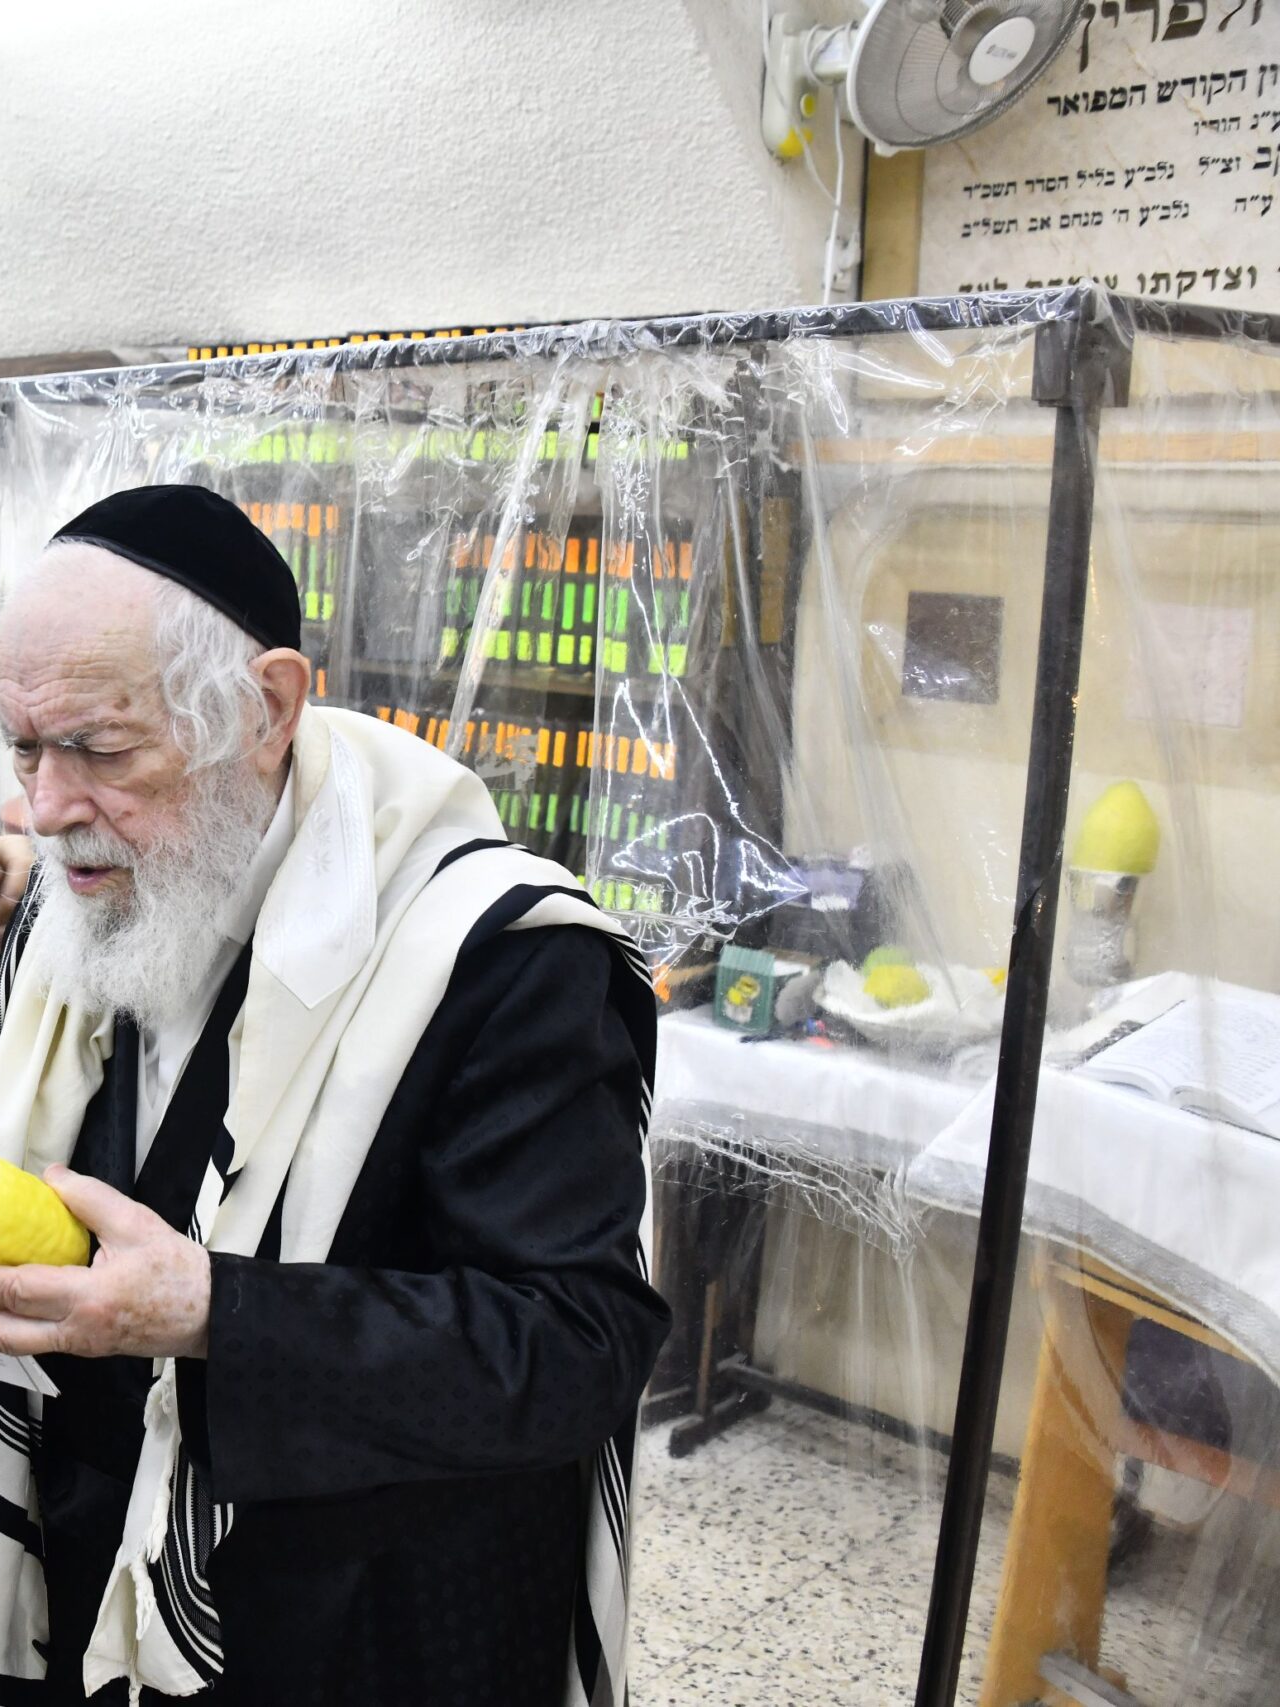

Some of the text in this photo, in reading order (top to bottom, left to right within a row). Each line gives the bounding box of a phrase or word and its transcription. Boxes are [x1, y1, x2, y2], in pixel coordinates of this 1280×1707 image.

[1157, 69, 1248, 106] הקודש
[1046, 84, 1147, 117] המפואר
[1024, 175, 1069, 193] הסדר
[1076, 168, 1115, 189] בליל
[1028, 215, 1052, 232] אב
[1059, 211, 1103, 229] מנחם
[1136, 265, 1257, 299] וצדקתו
